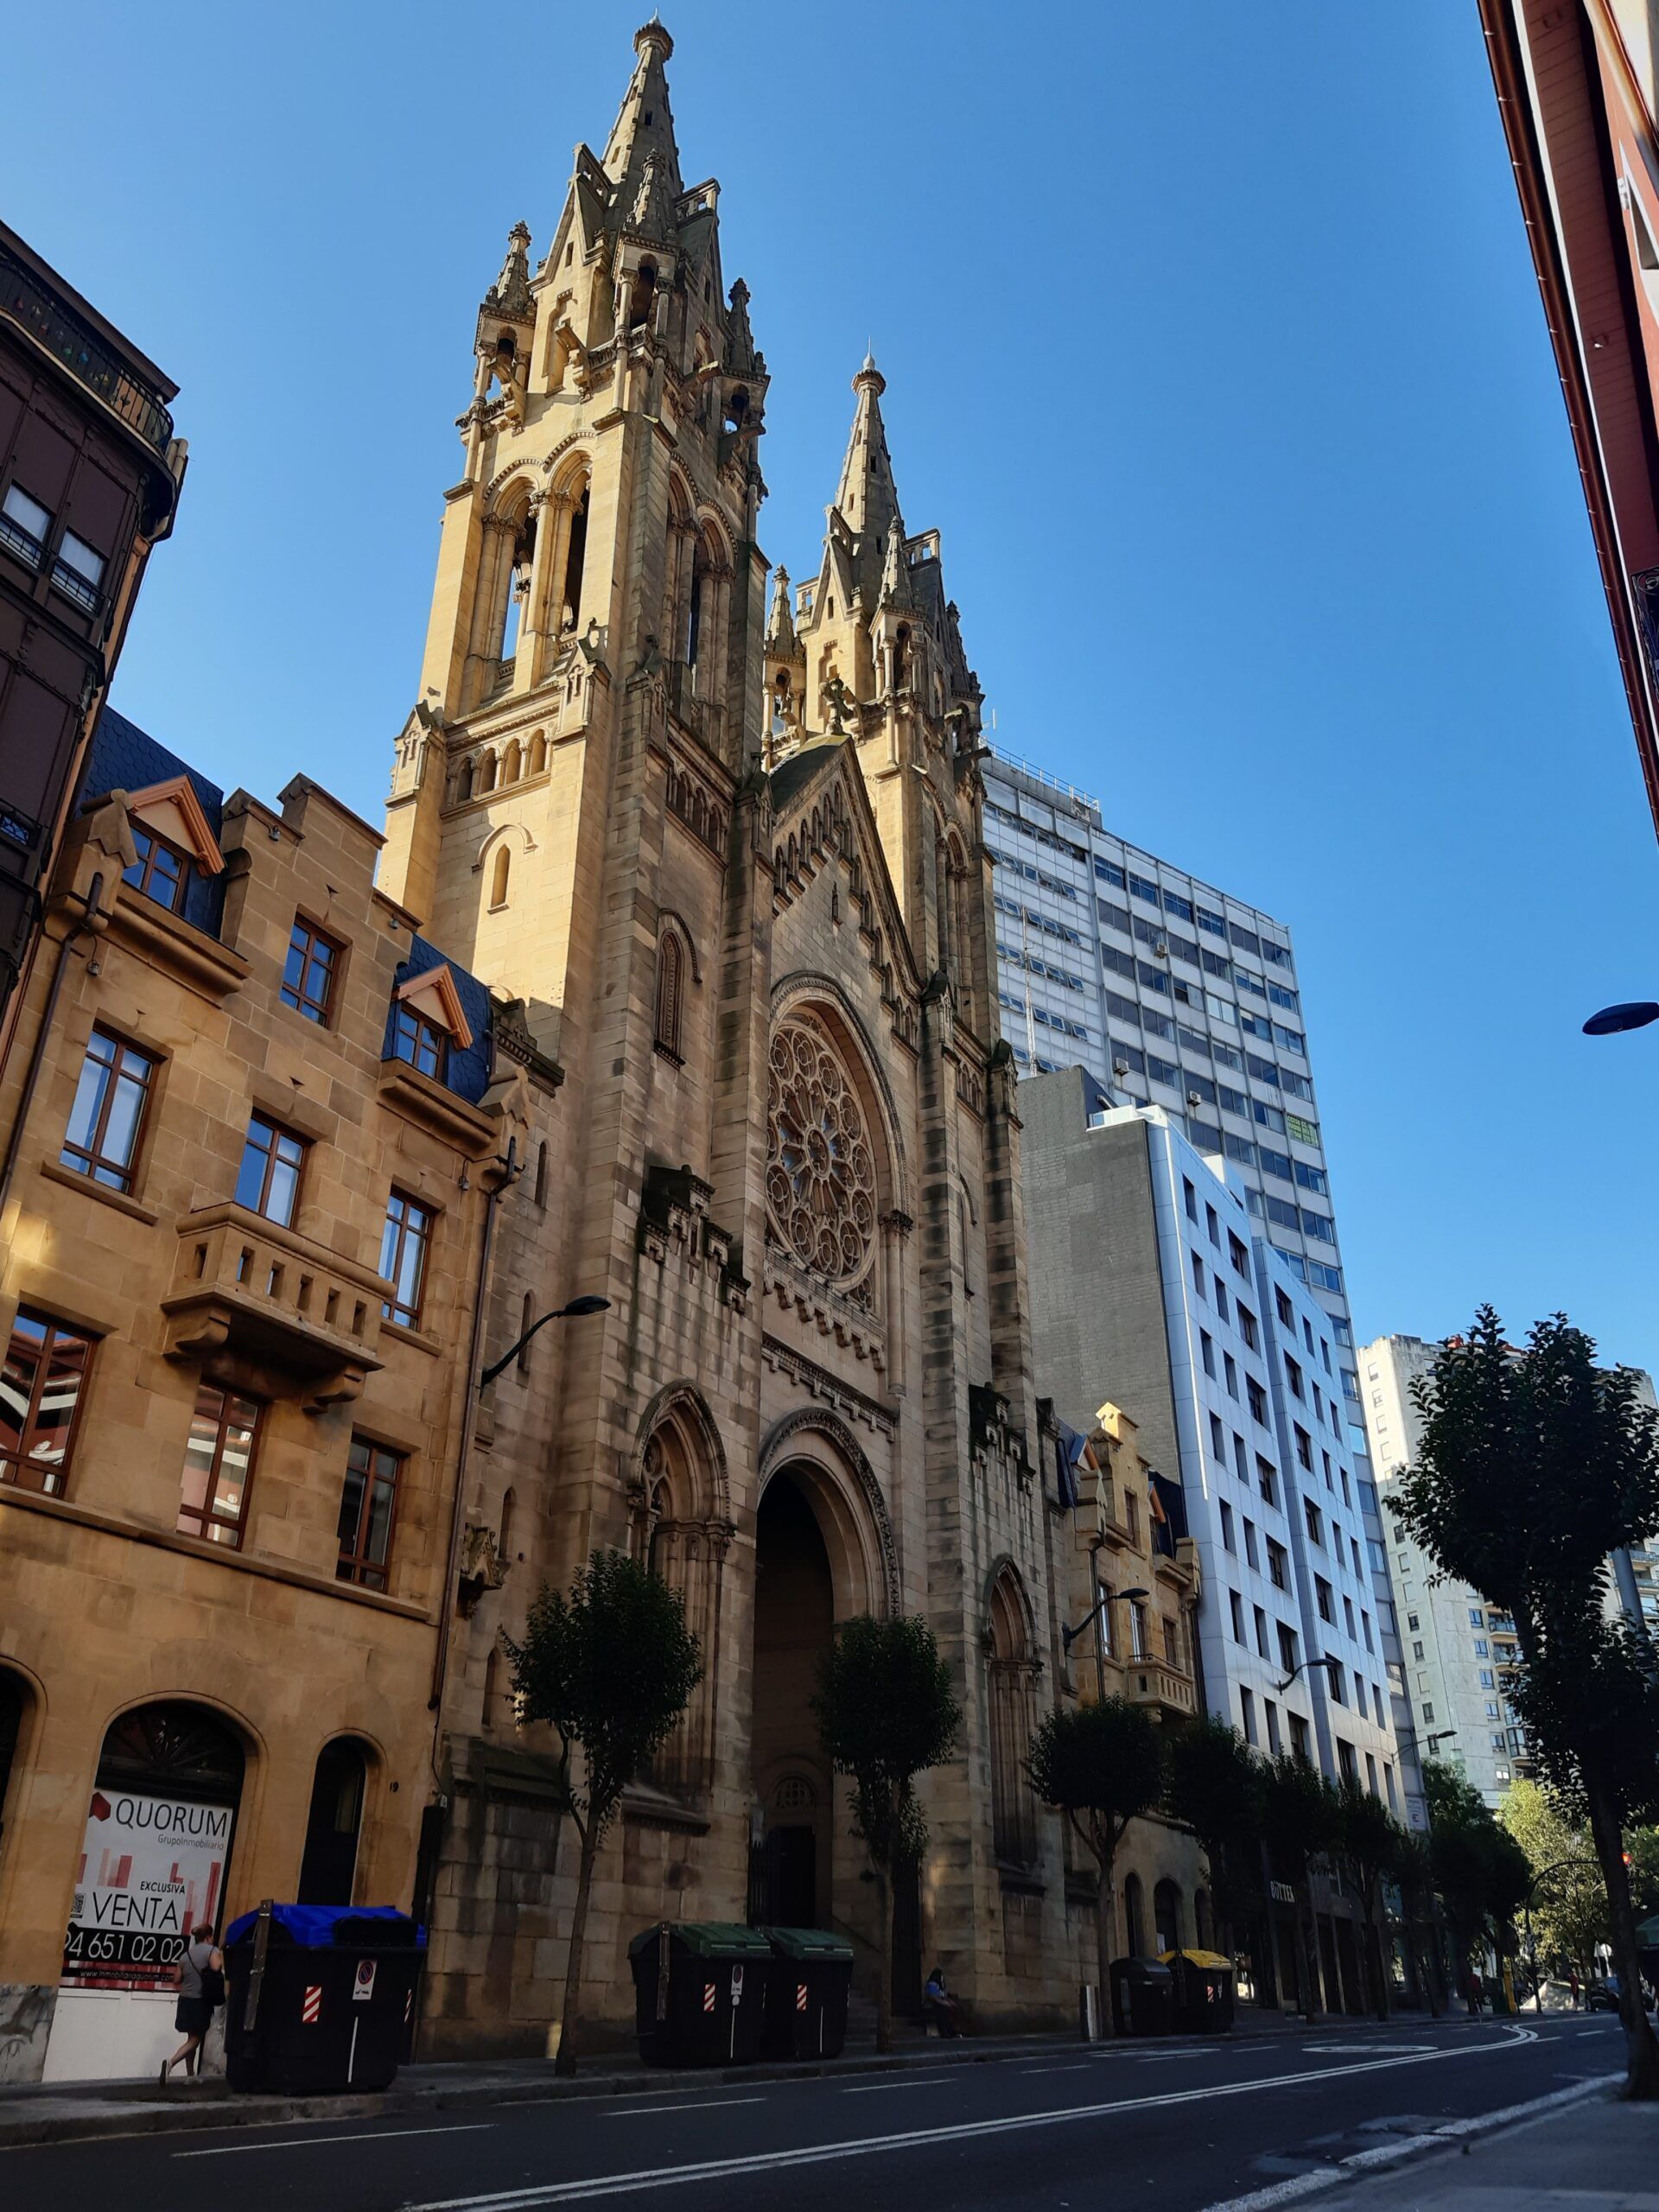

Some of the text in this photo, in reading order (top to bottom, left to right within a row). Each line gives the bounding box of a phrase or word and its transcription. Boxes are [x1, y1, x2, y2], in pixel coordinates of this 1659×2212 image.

[389, 1781, 399, 1793] 19
[116, 1798, 228, 1838] QUORUM
[140, 1881, 186, 1895] EXCLUSIVA
[92, 1891, 178, 1931] VENTA
[88, 1932, 125, 1960] 651
[130, 1936, 156, 1962] 02
[160, 1937, 185, 1964] 02
